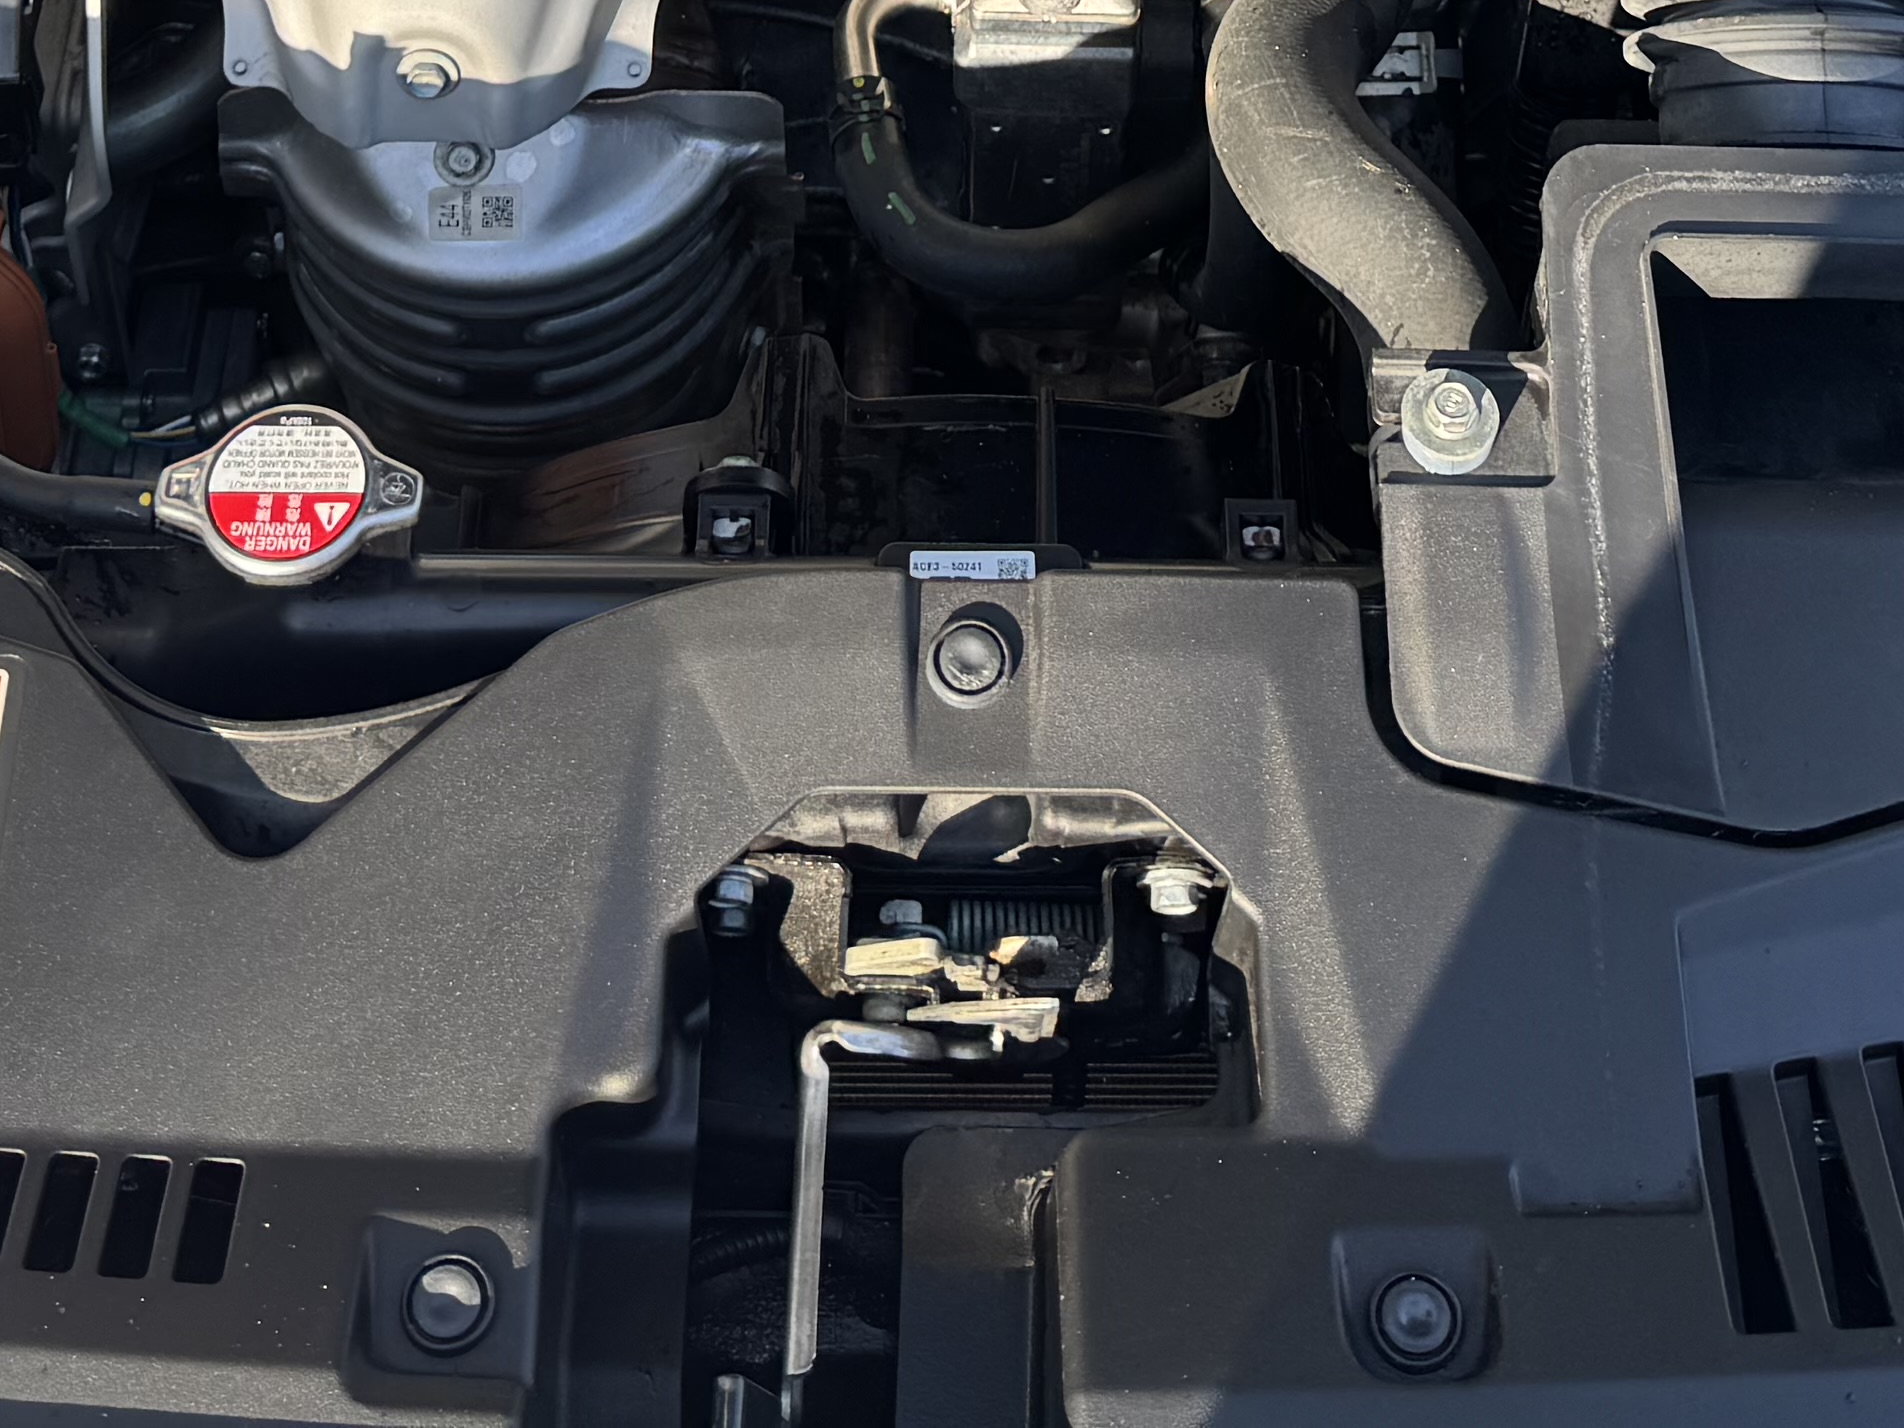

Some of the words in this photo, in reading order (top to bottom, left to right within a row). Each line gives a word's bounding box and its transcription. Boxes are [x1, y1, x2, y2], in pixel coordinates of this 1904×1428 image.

[439, 204, 459, 228] E44
[257, 459, 289, 467] QUAND
[252, 480, 280, 488] WHEN
[284, 480, 311, 488] OPEN
[314, 480, 348, 488] NEVER
[230, 521, 311, 536] WARNUNG
[243, 536, 311, 551] DANGER
